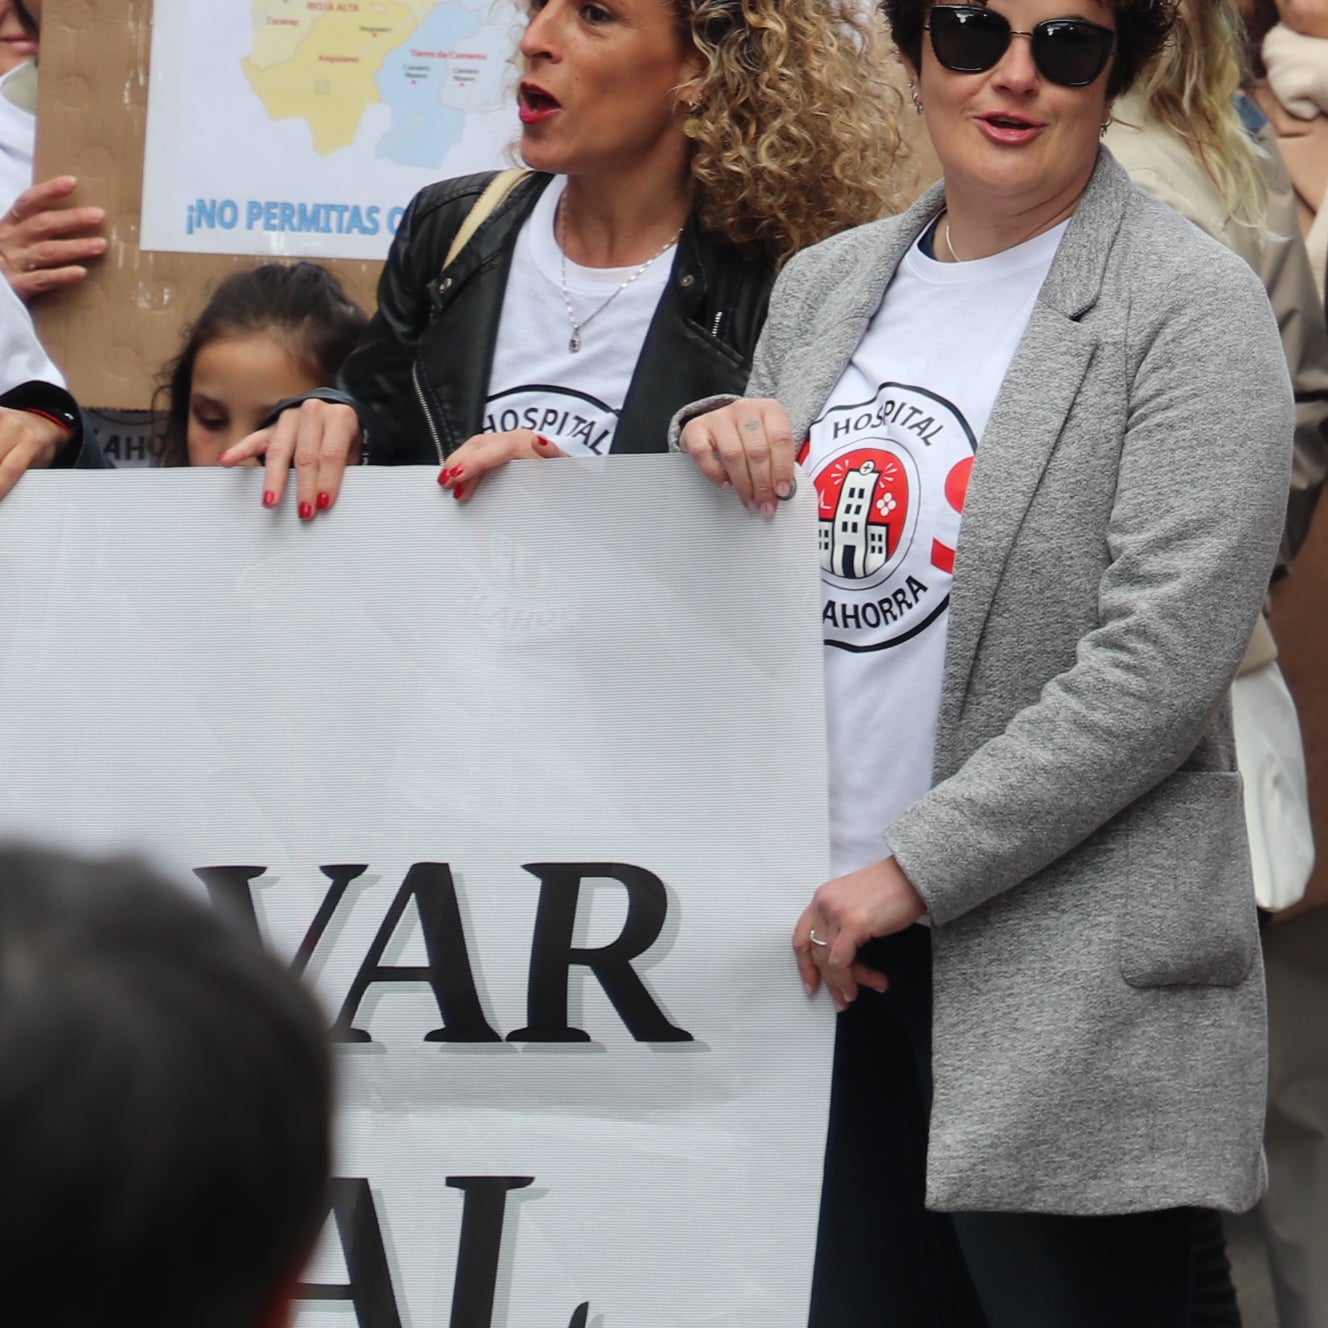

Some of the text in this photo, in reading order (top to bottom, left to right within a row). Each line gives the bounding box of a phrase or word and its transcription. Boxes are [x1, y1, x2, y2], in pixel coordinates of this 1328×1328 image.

[186, 199, 238, 235] ¡NO
[246, 201, 380, 236] PERMITAS
[832, 399, 944, 447] HOSPITAL
